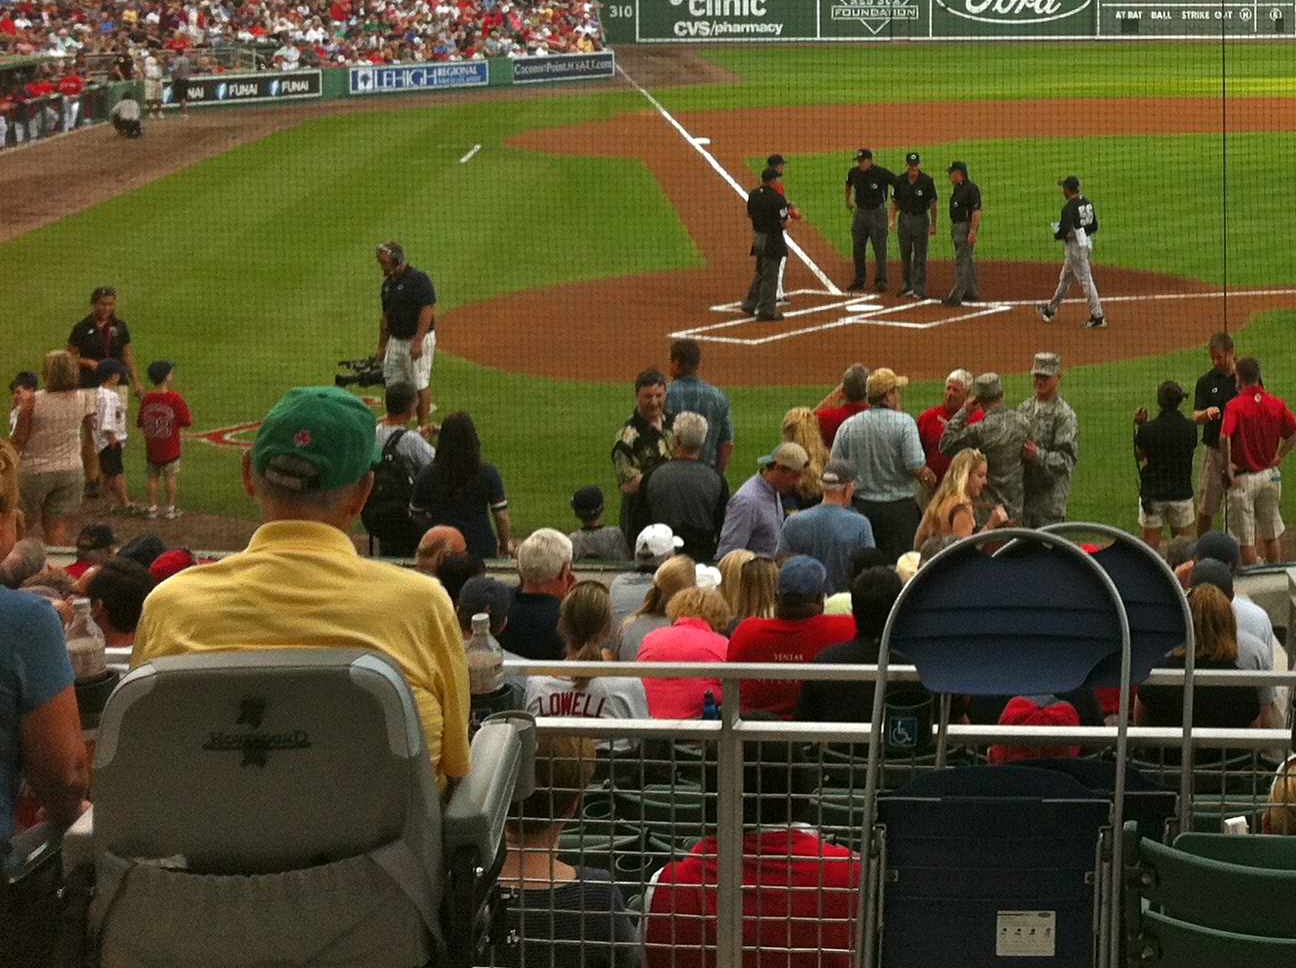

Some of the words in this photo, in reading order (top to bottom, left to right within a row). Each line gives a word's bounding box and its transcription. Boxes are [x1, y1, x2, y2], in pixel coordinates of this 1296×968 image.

[609, 5, 633, 17] 310
[835, 8, 916, 17] FOUNDATION
[1151, 11, 1172, 20] BALL
[1182, 11, 1210, 19] STRIKE
[673, 20, 783, 36] CVS/pharmacy
[375, 68, 437, 89] LEHIGH
[187, 87, 204, 99] NAI
[229, 84, 258, 97] FUNAI
[282, 81, 309, 93] FUNAI
[538, 691, 606, 718] LOWELL
